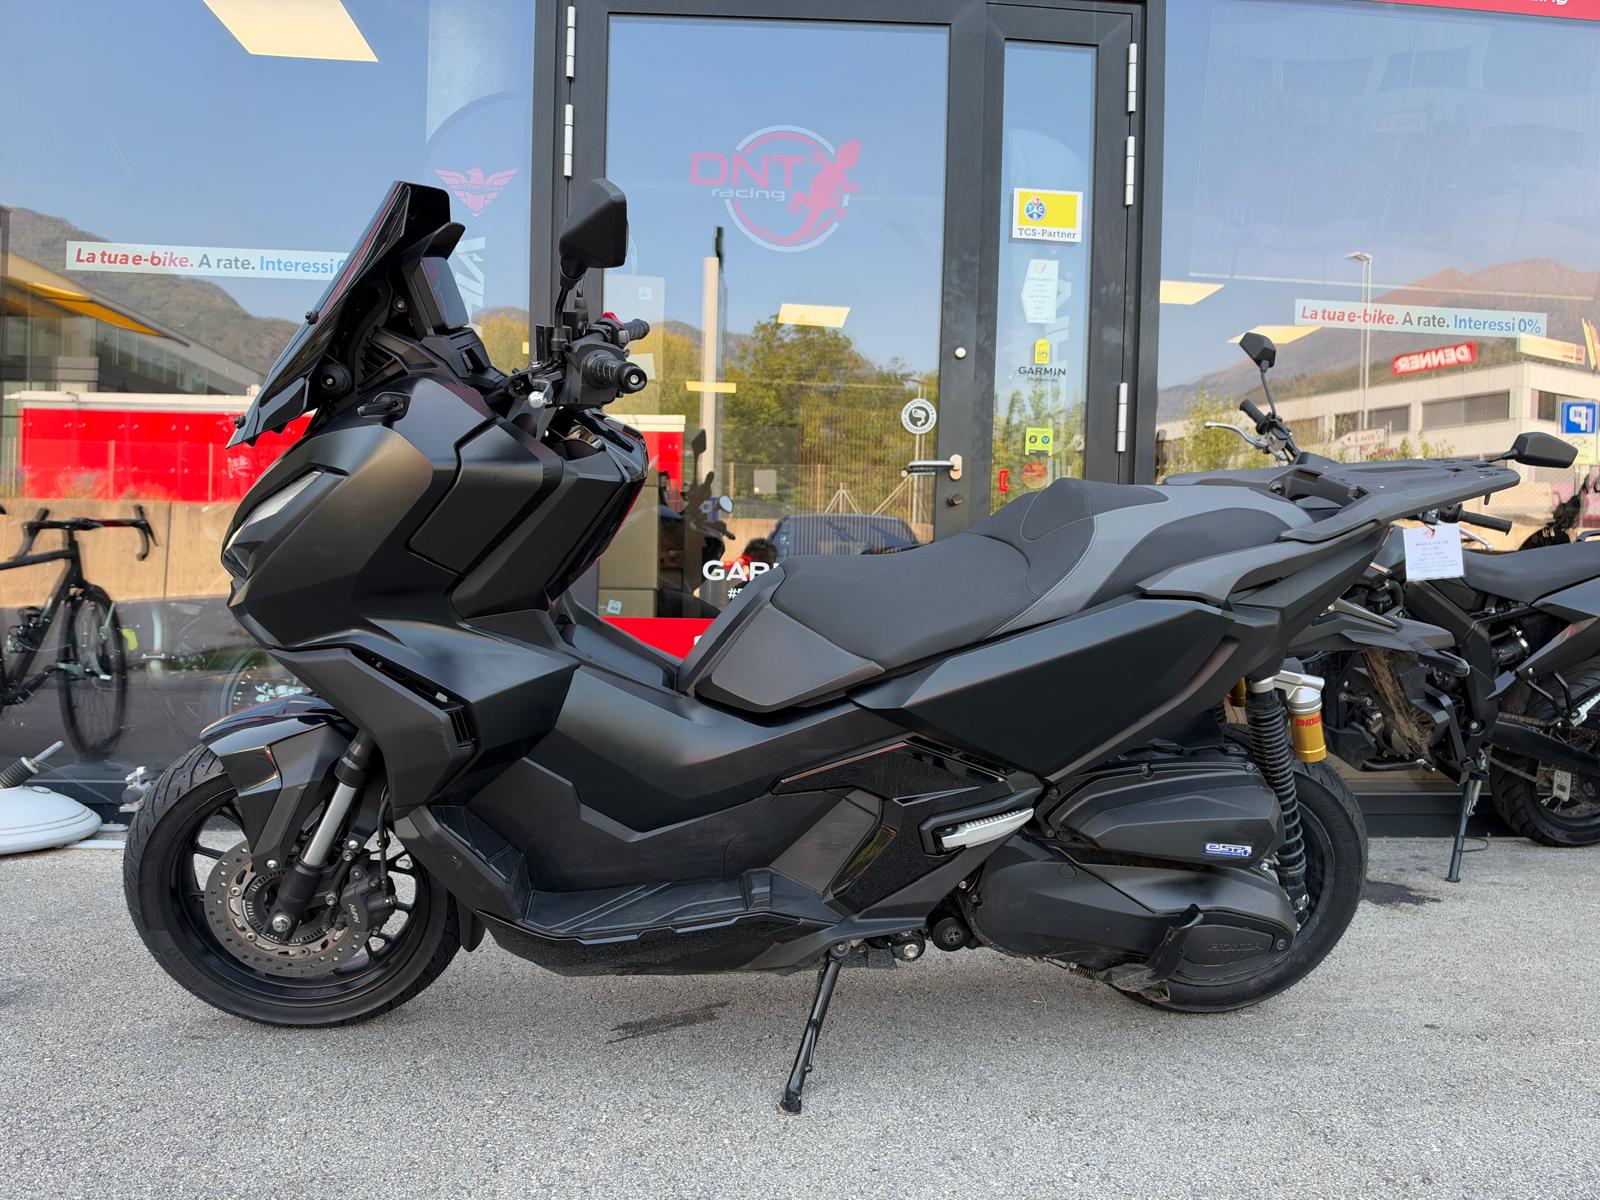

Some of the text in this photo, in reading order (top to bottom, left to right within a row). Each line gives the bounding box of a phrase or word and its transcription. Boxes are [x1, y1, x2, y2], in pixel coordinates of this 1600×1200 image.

[690, 151, 805, 188] DNT
[711, 187, 785, 201] racing
[1017, 227, 1077, 239] TCS-Partner
[75, 247, 96, 263] La
[100, 250, 129, 265] tua
[132, 251, 194, 268] e-bike.
[198, 253, 212, 269] A
[216, 255, 256, 270] rate.
[259, 255, 334, 274] Interessi
[1301, 305, 1541, 334] La tua e-bike. A rate. Interessi 0%
[1018, 366, 1066, 376] GARMIN
